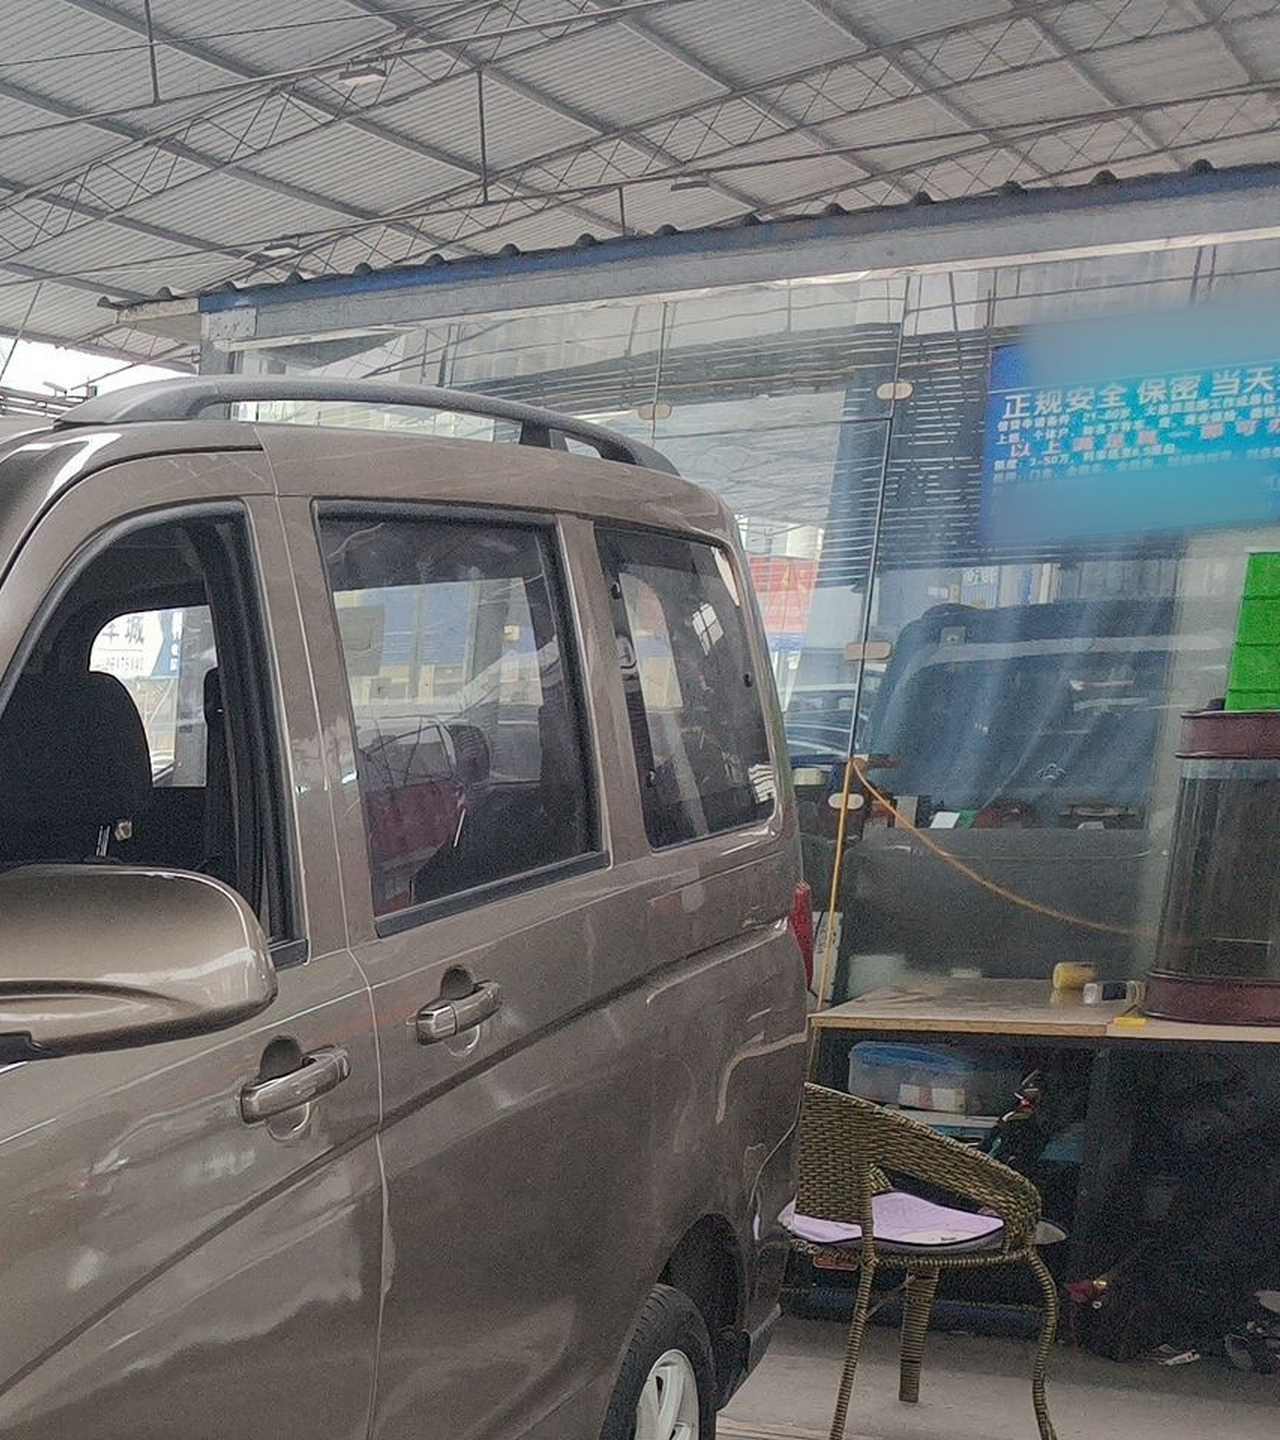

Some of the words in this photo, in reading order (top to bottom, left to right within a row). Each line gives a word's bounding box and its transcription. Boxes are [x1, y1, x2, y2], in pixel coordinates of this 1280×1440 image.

[1002, 382, 1128, 419] 正规安全
[1137, 374, 1201, 405] 保密
[1210, 366, 1280, 397] 当天
